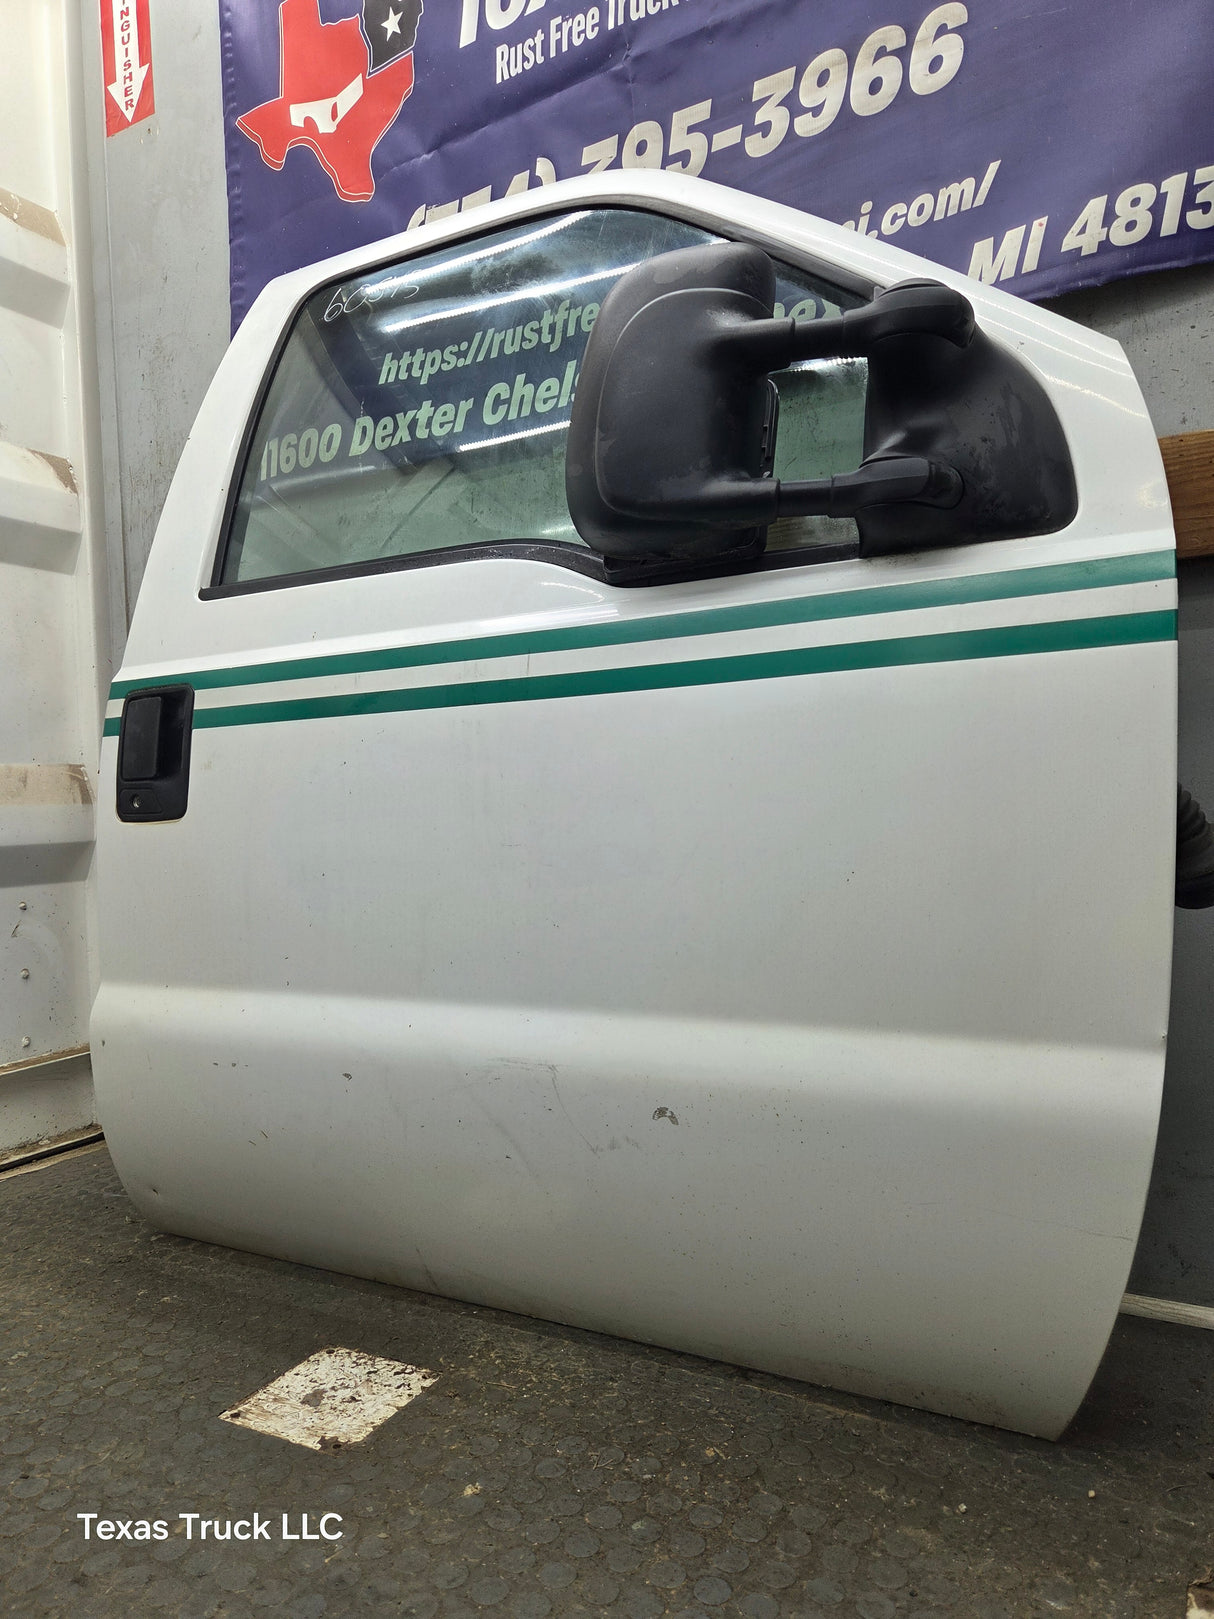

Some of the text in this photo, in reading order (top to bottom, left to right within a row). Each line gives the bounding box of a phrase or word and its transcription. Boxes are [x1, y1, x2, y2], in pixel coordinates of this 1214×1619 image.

[496, 28, 545, 84] Rust
[550, 6, 600, 59] Free
[606, 0, 681, 31] Truc
[348, 397, 474, 457] Dexter
[481, 359, 580, 425] Chel
[967, 215, 1049, 286] MI
